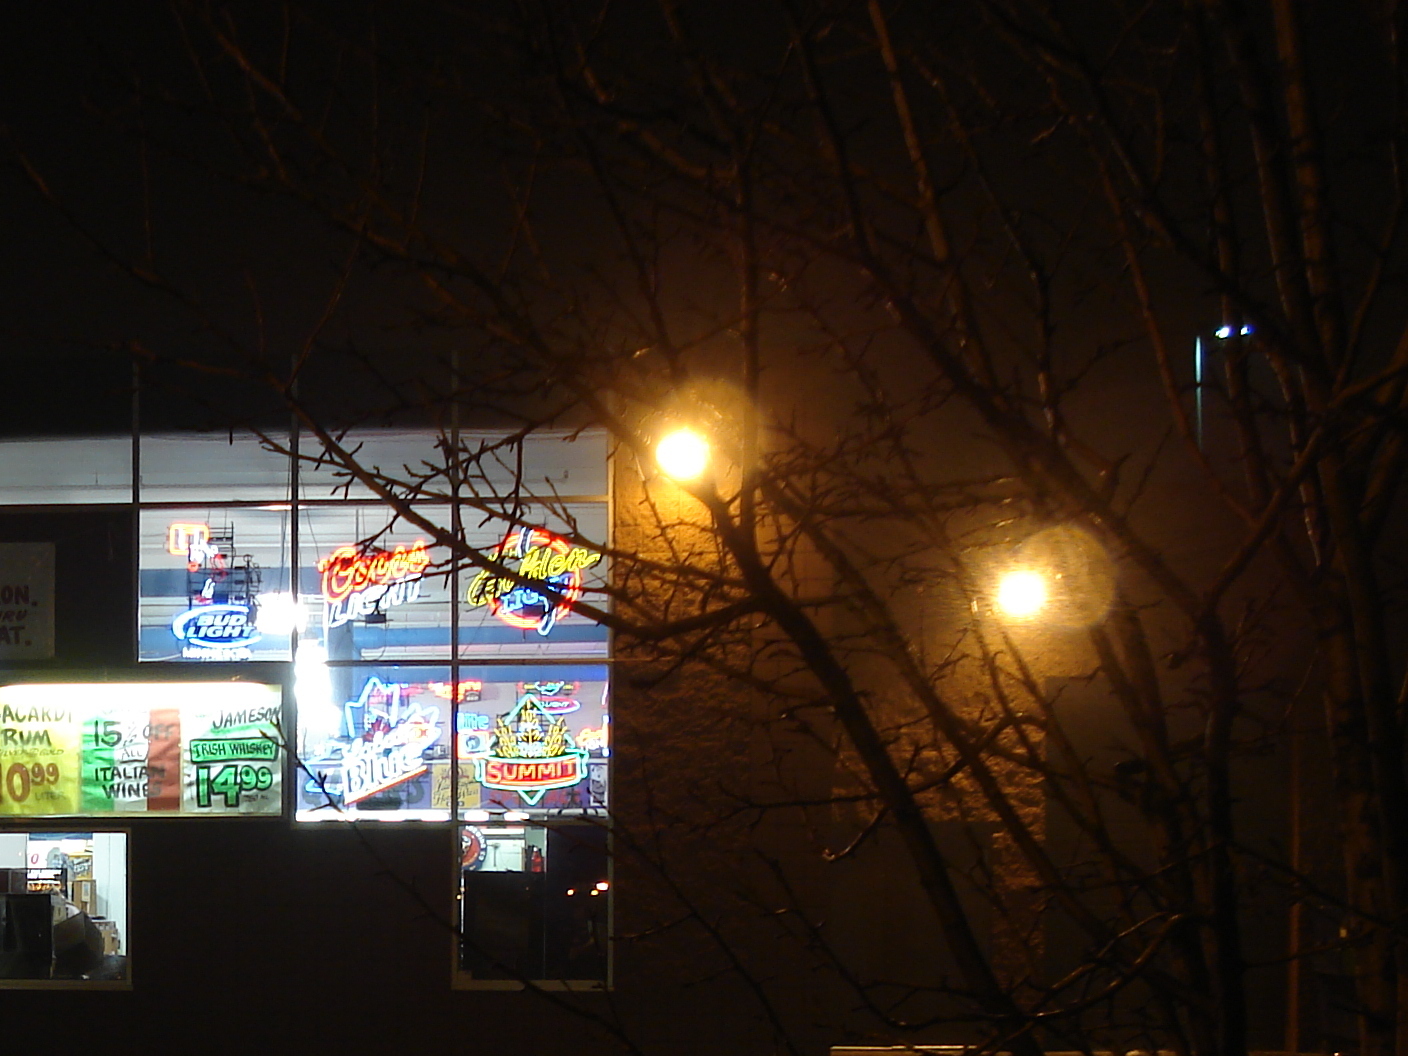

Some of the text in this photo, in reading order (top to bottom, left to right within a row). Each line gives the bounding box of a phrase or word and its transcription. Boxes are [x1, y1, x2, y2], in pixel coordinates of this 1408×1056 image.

[196, 614, 248, 627] BUD
[186, 626, 253, 639] LIGHT
[212, 704, 282, 730] JAMESON
[0, 728, 53, 747] RUM
[193, 743, 227, 758] IRISH
[94, 766, 166, 782] ITALIAN
[485, 758, 578, 784] SUMMIT
